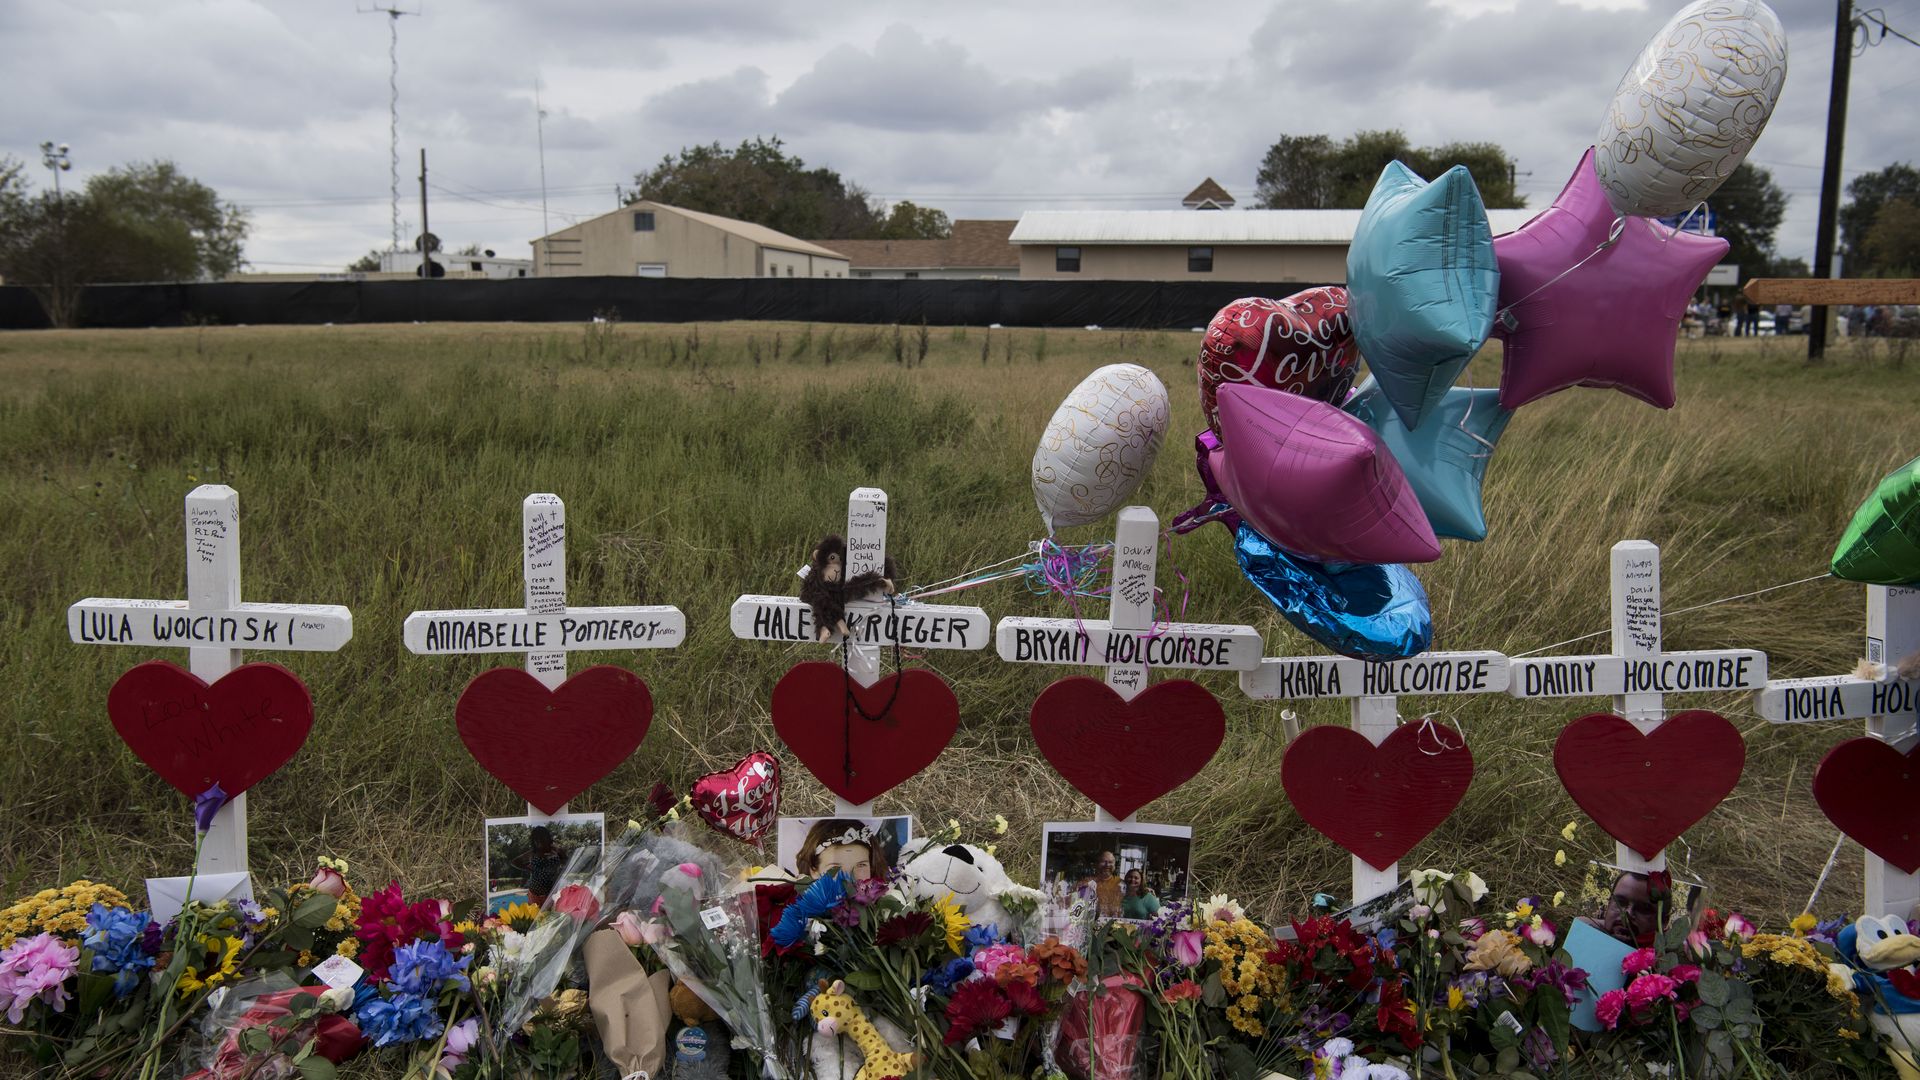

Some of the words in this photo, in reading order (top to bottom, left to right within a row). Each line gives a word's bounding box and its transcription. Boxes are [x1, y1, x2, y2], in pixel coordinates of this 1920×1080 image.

[1219, 311, 1345, 388] Love
[850, 538, 880, 551] Beloved
[1123, 545, 1152, 555] David
[80, 610, 133, 642] LULA
[426, 620, 547, 651] ANNABELLE
[559, 618, 661, 646] POMEROY
[754, 605, 819, 641] HALE
[847, 611, 970, 648] KRUEGER
[1016, 628, 1090, 661] BRYAN
[1105, 633, 1233, 666] HOLCOMBE
[1280, 661, 1341, 698] KARLA
[1363, 659, 1489, 695] HOLCOMBE
[1525, 661, 1595, 696] DANNY
[1624, 657, 1752, 693] HOLCOMBE
[1785, 687, 1844, 721] NOHA
[730, 776, 774, 814] Love
